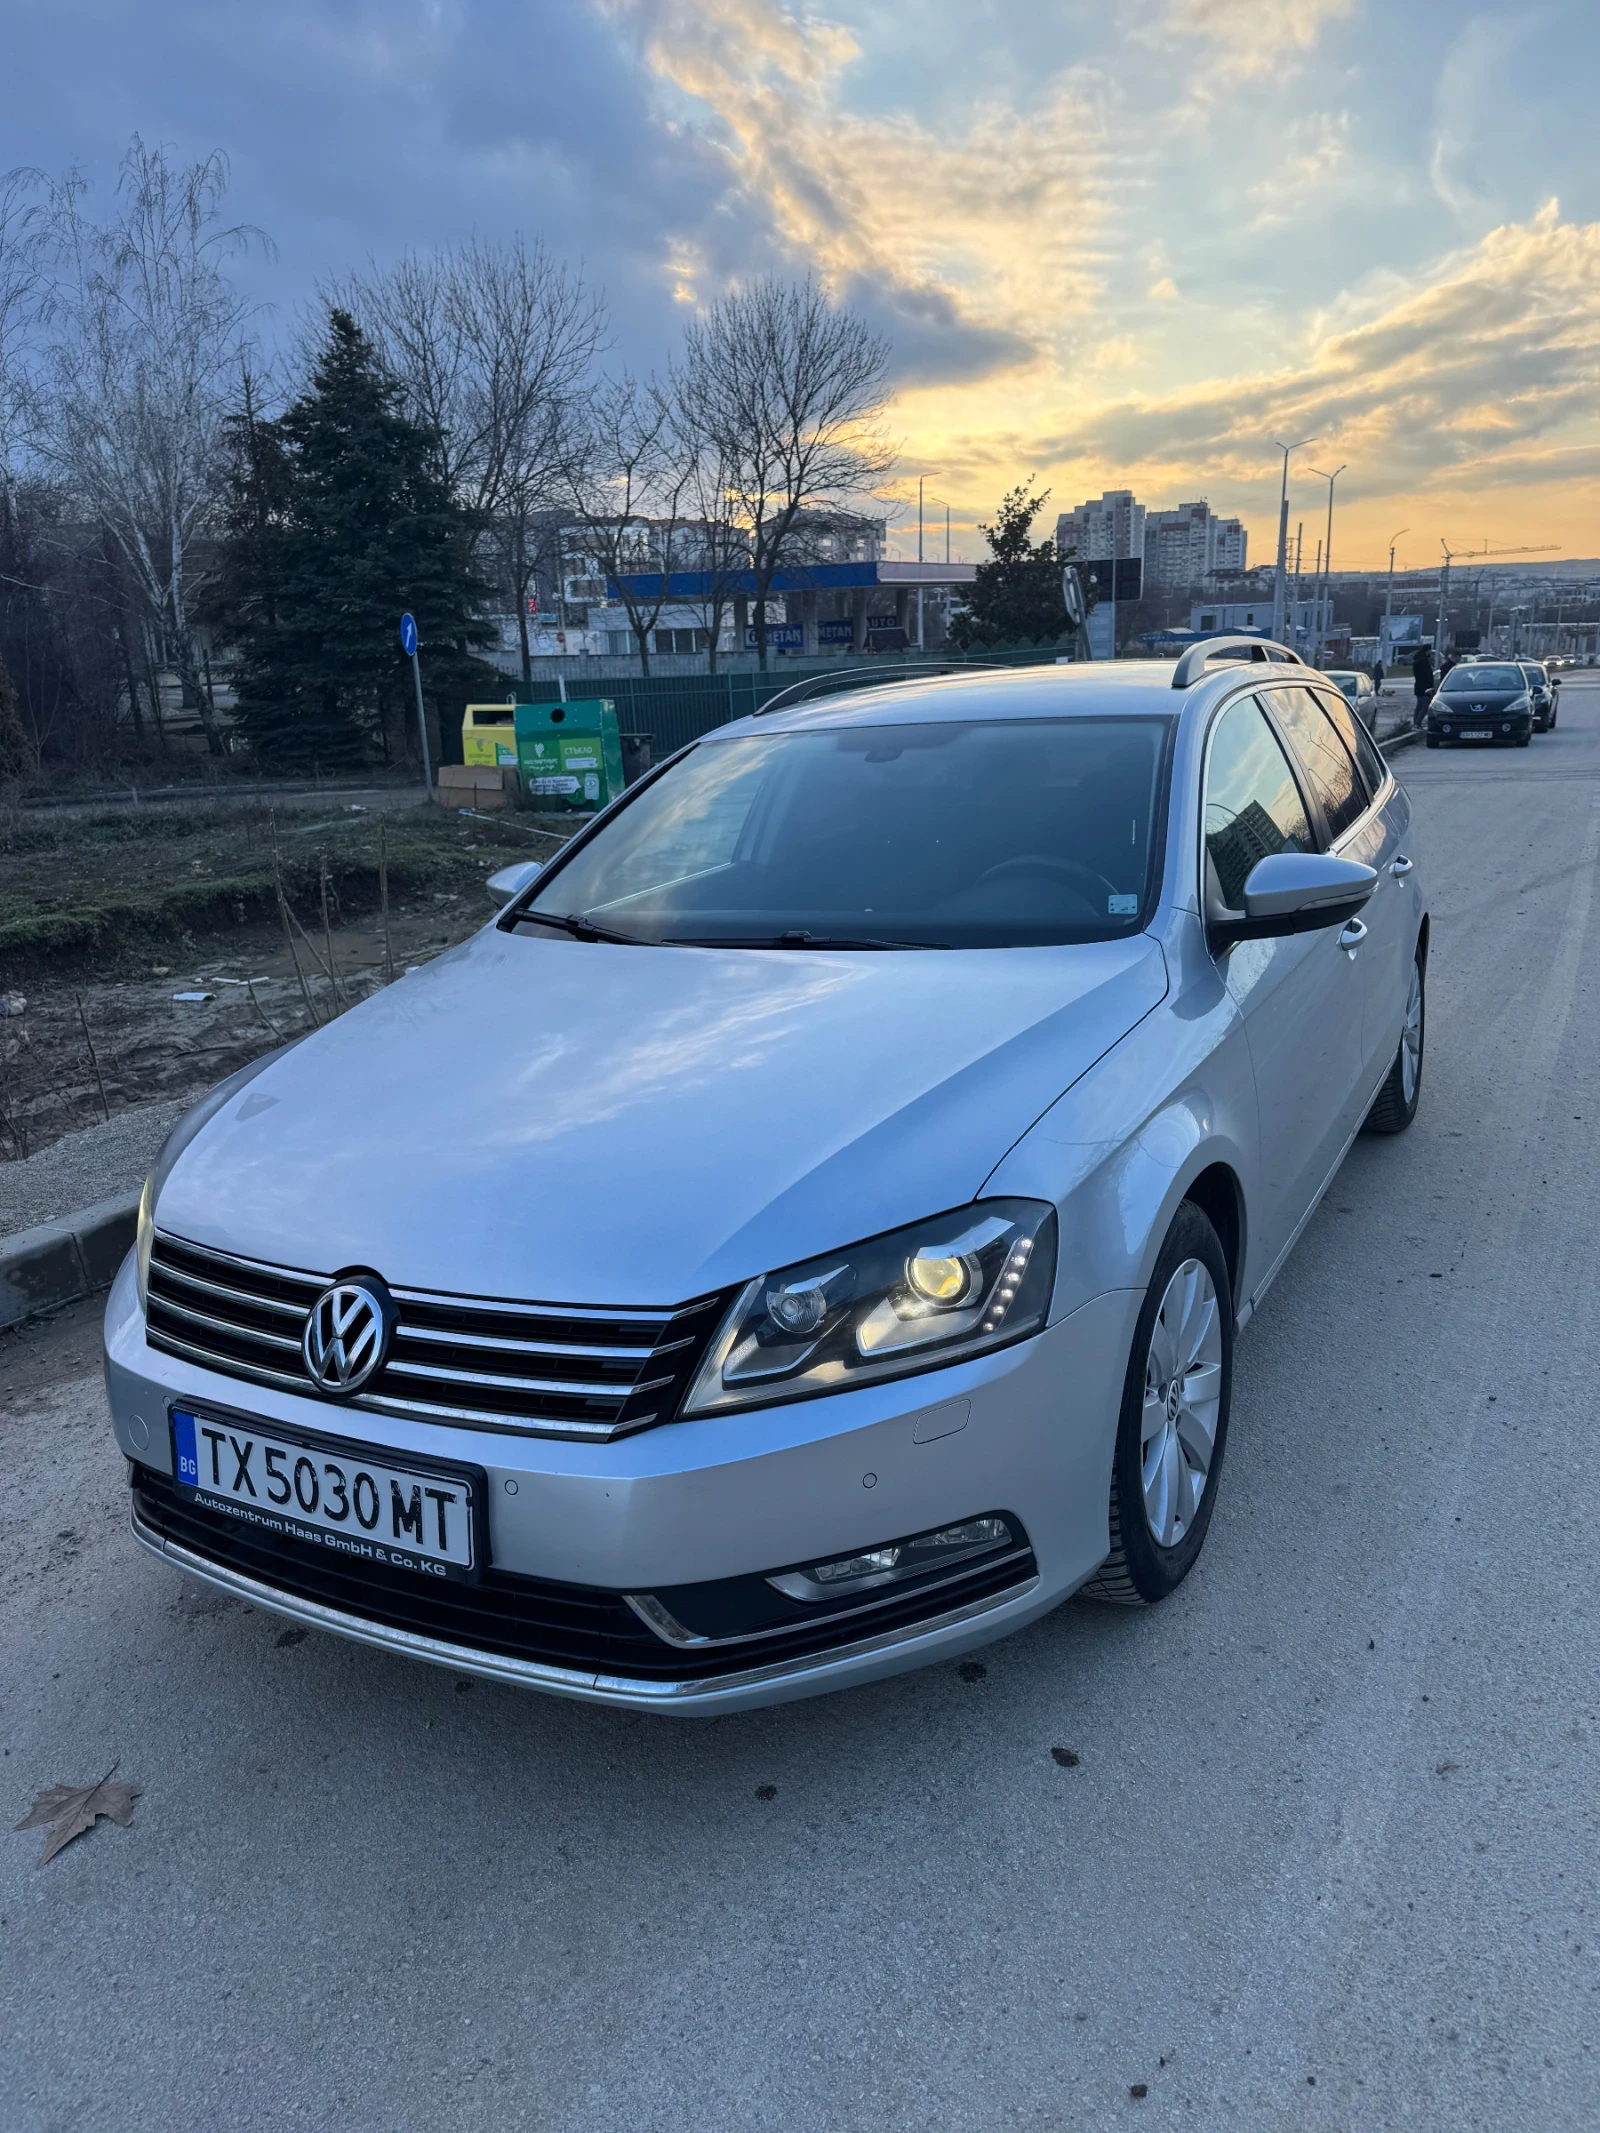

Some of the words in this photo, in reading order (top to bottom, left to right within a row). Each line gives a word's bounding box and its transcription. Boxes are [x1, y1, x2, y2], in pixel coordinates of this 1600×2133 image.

[180, 1456, 196, 1475] BG
[194, 1492, 283, 1531] Autozentrum
[285, 1522, 322, 1543] Haas
[324, 1533, 373, 1558] GmbH
[375, 1547, 387, 1560] &
[391, 1552, 418, 1569] Co.
[421, 1560, 447, 1577] KG
